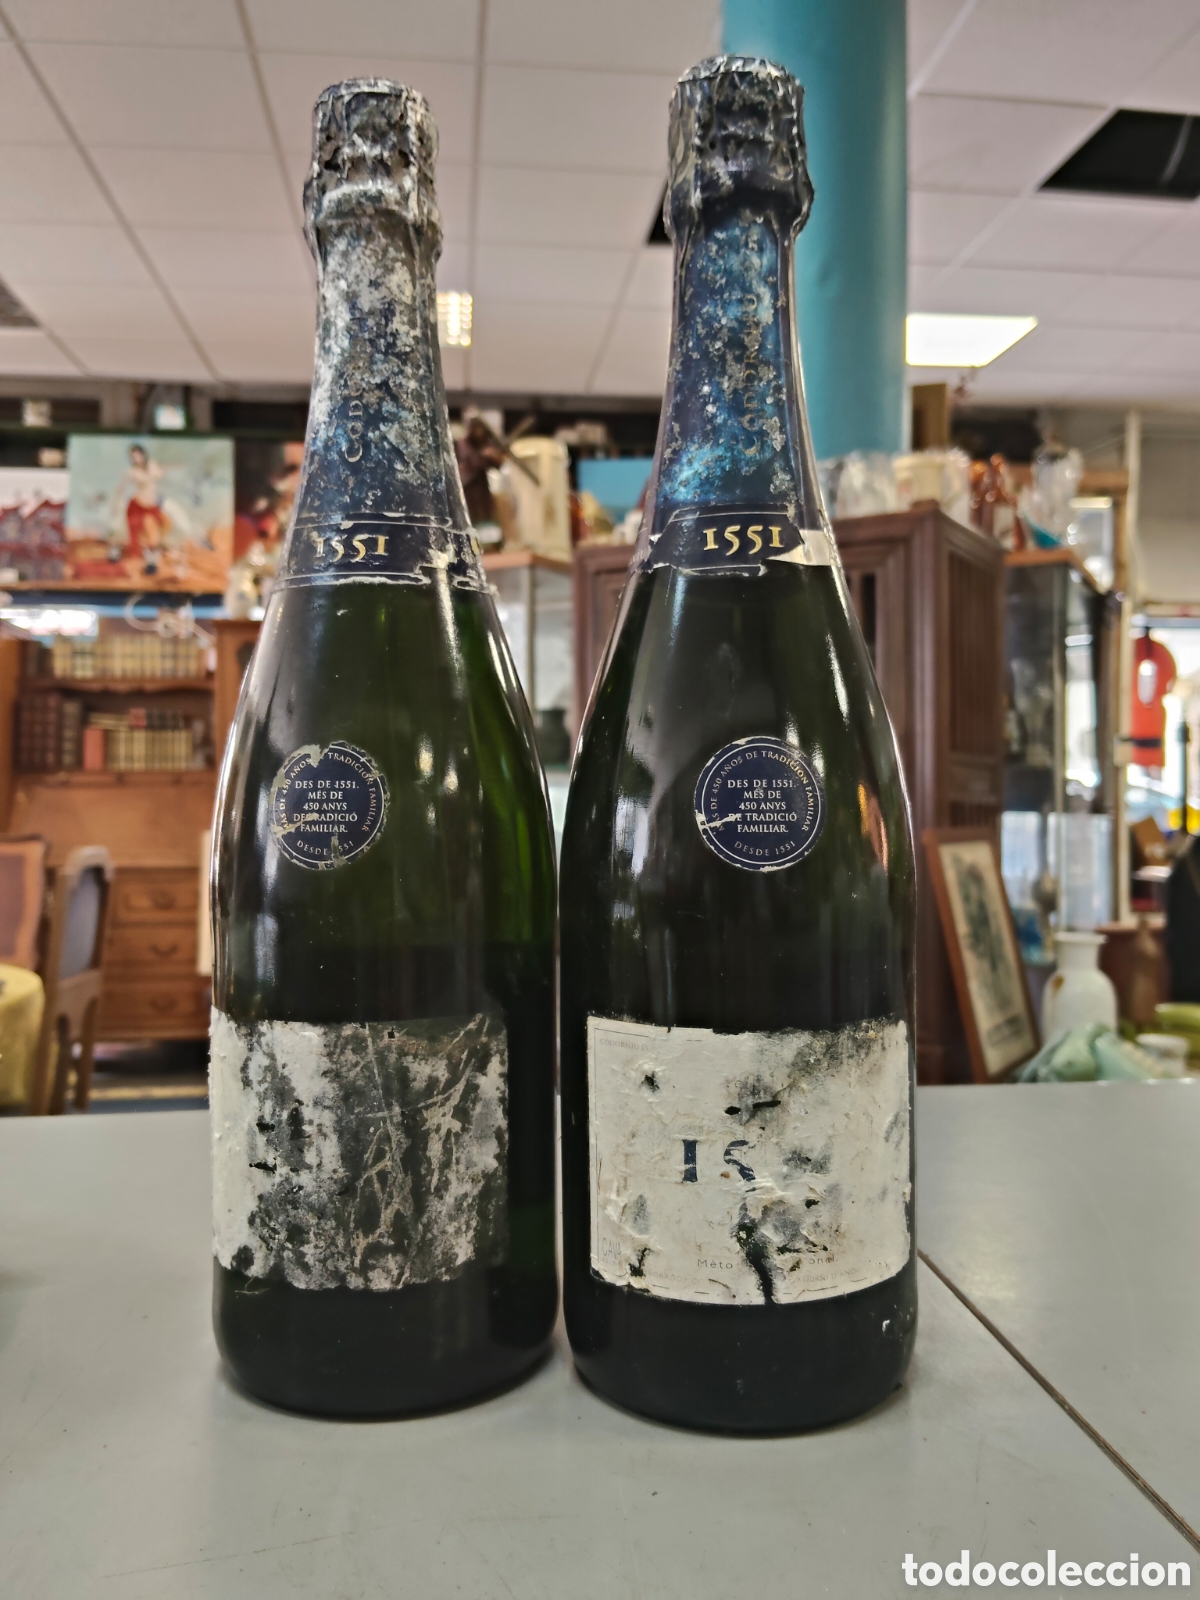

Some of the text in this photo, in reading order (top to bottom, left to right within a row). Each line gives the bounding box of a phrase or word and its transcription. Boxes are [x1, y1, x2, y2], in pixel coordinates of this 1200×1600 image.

[703, 524, 783, 556] 1551
[311, 533, 389, 563] 1551
[745, 750, 759, 760] DE
[720, 755, 743, 777] AÑOS
[295, 780, 313, 789] DES
[318, 780, 331, 789] DE
[712, 778, 723, 794] 450
[727, 779, 797, 789] DES DE 1551.
[279, 799, 286, 810] DE
[283, 779, 292, 795] 450
[307, 790, 343, 800] MÉS DE
[743, 789, 782, 799] MÉS DE
[302, 802, 347, 810] 450 ANYS
[710, 797, 718, 810] DE
[738, 802, 786, 810] 450 ANYS
[801, 786, 814, 831] FAMILIAR
[745, 811, 797, 822] TRADICIÓ
[300, 824, 348, 833] FAMILIAR.
[737, 825, 788, 833] FAMILIAR.
[296, 840, 329, 856] DESDE
[734, 840, 796, 856] DESDE 1551
